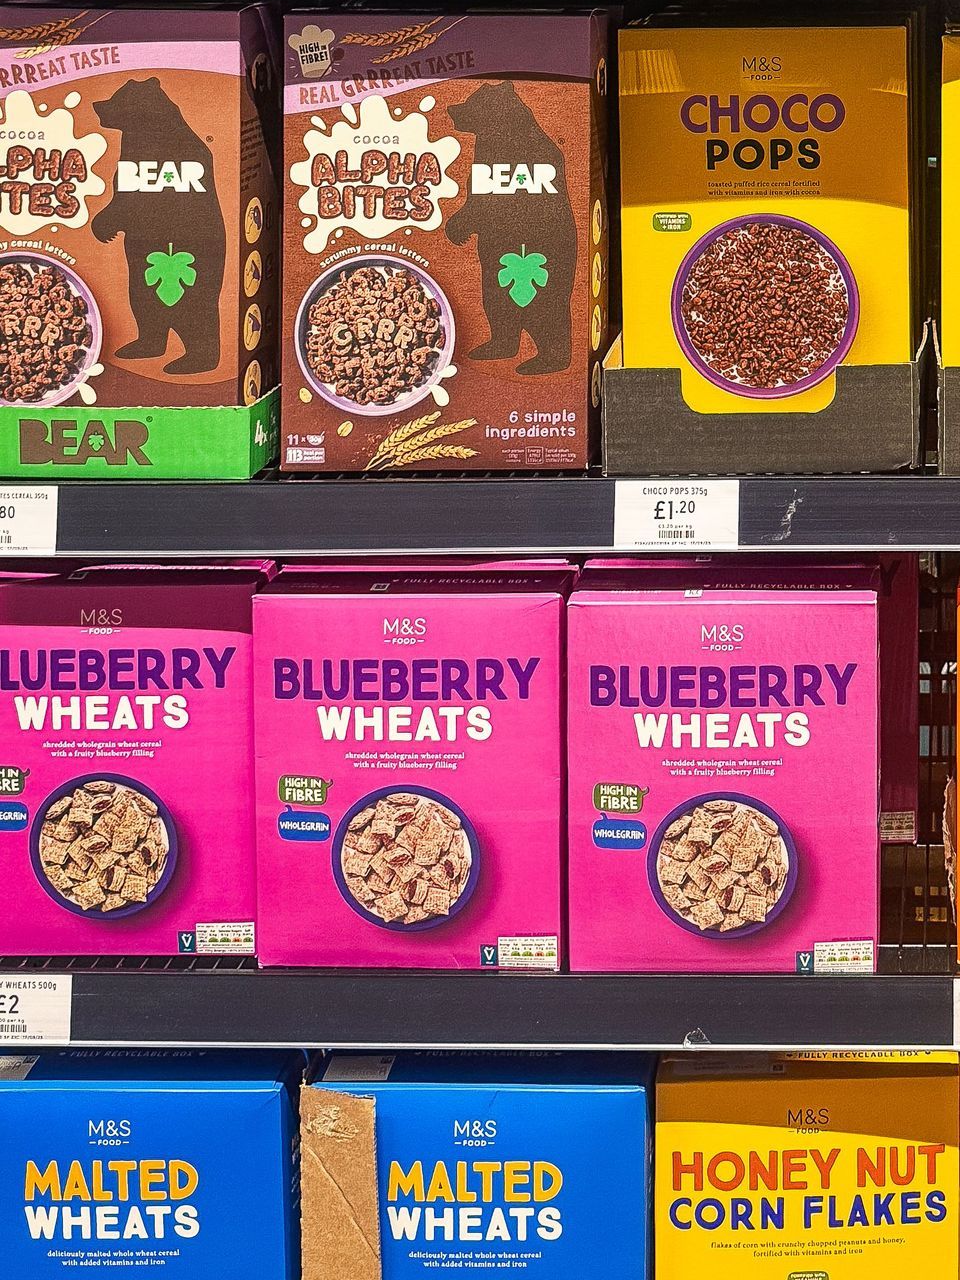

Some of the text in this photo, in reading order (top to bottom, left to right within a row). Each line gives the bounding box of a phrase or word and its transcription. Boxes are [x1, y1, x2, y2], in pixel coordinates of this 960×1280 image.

[299, 42, 320, 55] HIGH
[299, 84, 340, 105] REAL
[425, 50, 475, 74] TASTE
[680, 94, 846, 133] CHOCO
[353, 134, 400, 144] cocoa
[706, 139, 821, 171] POPS
[116, 161, 206, 193] BEAR
[310, 149, 441, 185] ALPHA
[471, 163, 557, 194] BEAR
[318, 186, 435, 221] BITES
[319, 243, 430, 268] scrummy cereal letters
[485, 424, 577, 440] ingredients
[509, 410, 576, 426] 6 simple
[19, 420, 153, 466] BEAR
[642, 487, 708, 496] CHOCO POPS 375g
[653, 500, 696, 520] £1.20
[383, 618, 426, 635] M&S
[273, 657, 540, 701] BLUEBERRY
[590, 663, 857, 707] BLUEBERRY
[14, 694, 190, 731] WHEATS
[316, 705, 494, 742] WHEATS
[633, 711, 811, 748] WHEATS
[284, 777, 322, 788] HIGH IN
[285, 788, 323, 802] FIBRE
[279, 821, 329, 832] WHOLEGRAIN
[6, 981, 57, 991] WHEATS 500g
[89, 1120, 131, 1137] M&S
[24, 1160, 200, 1202] MALTED
[671, 1143, 946, 1192] HONEY NUT
[25, 1205, 200, 1241] WHEATS
[668, 1190, 947, 1231] CORN FLAKES
